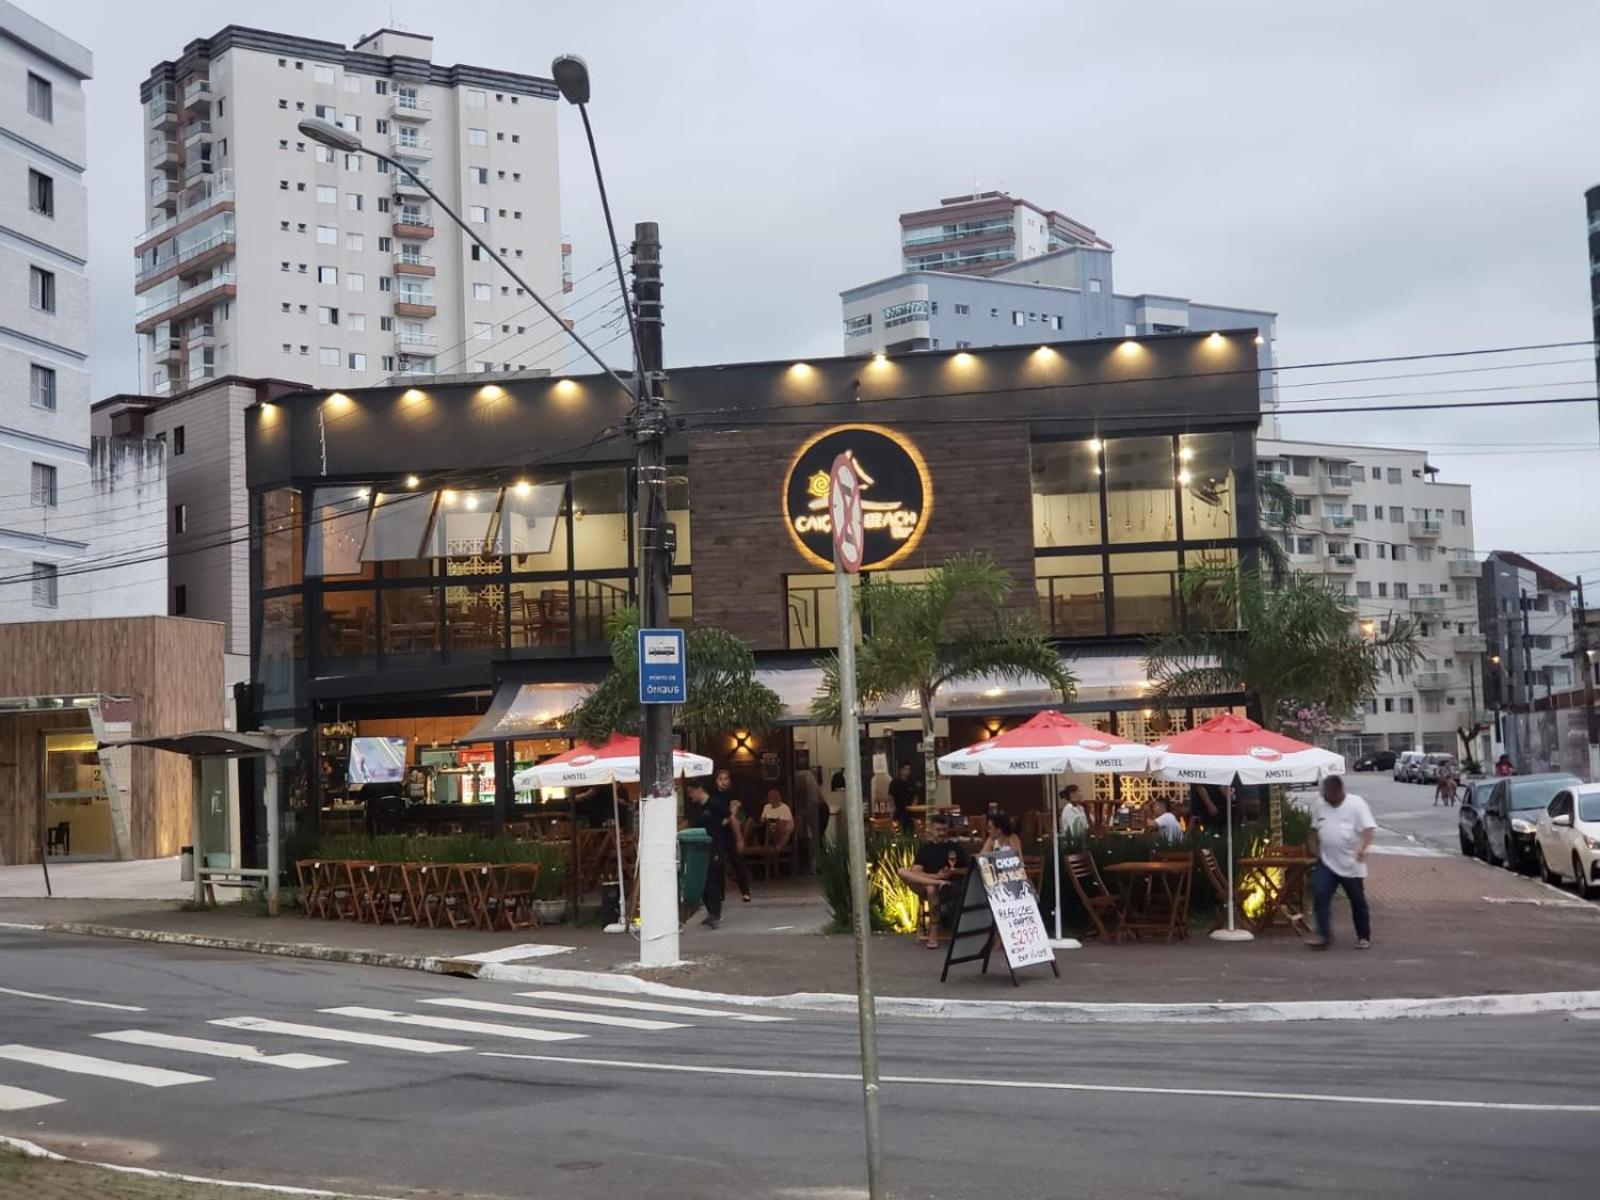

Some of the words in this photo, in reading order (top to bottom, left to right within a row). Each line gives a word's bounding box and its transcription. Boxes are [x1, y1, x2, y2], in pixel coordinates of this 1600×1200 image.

[647, 684, 680, 694] ÔNIBUS
[1009, 761, 1039, 769] AMSTEL
[1095, 759, 1123, 767] AMSTEL
[562, 772, 587, 780] AMSTEL
[1177, 769, 1207, 778] AMSTEL
[1264, 769, 1293, 778] AMSTEL
[996, 856, 1020, 869] CHOPP
